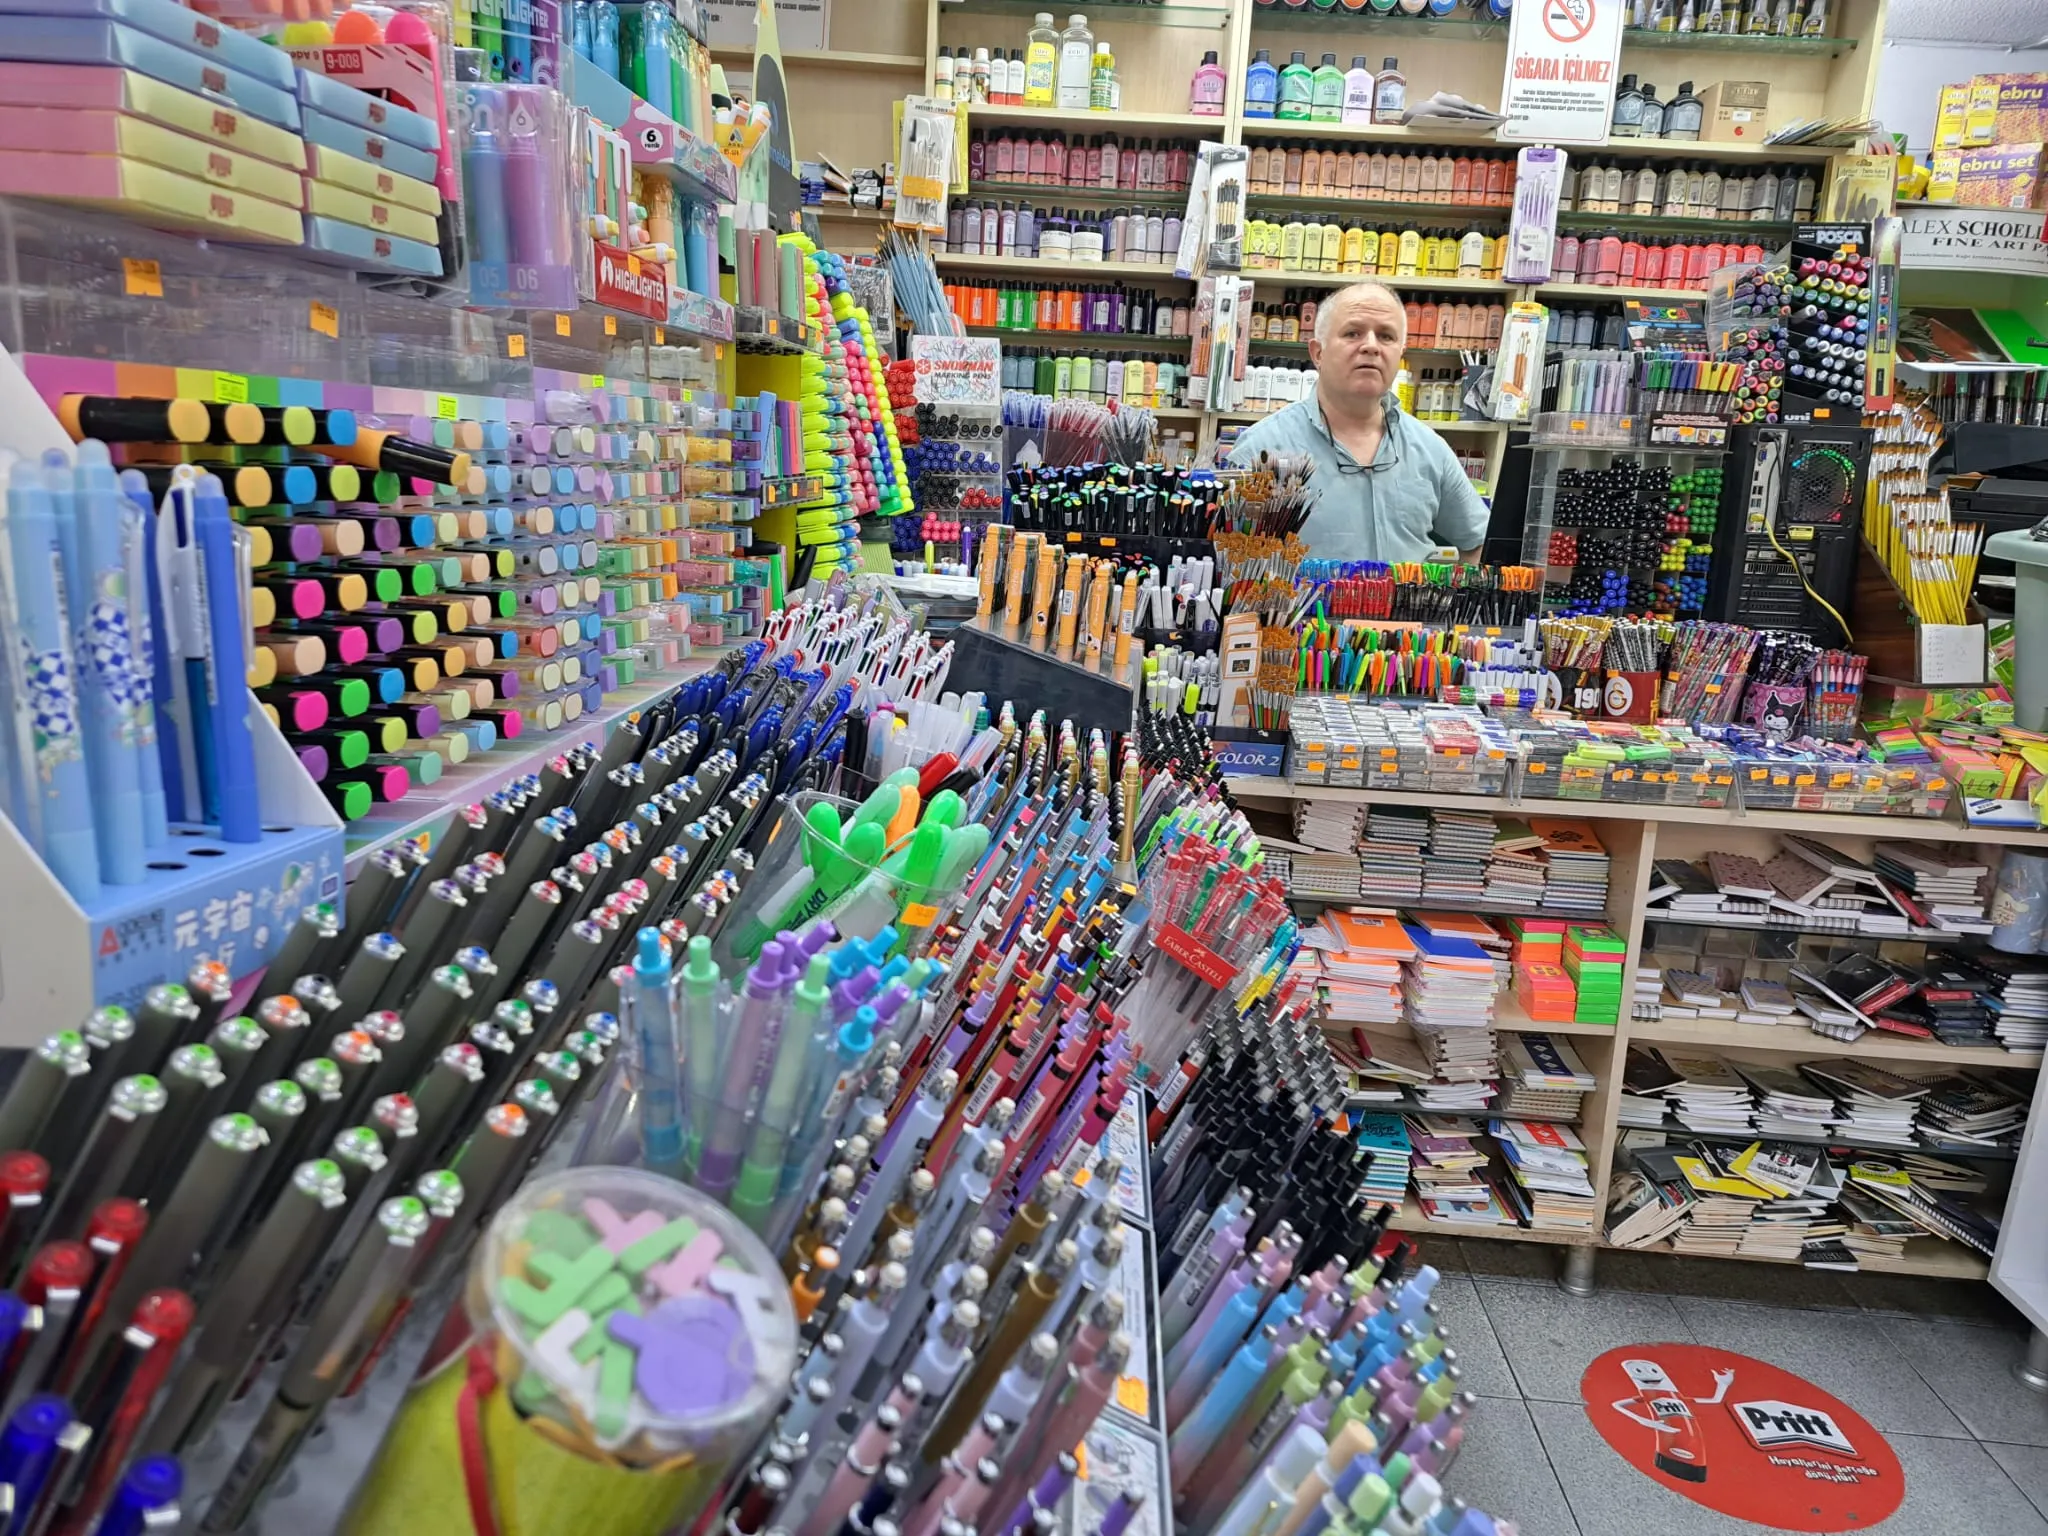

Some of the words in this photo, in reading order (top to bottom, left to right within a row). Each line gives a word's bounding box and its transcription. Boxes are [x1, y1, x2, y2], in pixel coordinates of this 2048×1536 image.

[1514, 55, 1560, 80] SİGARA
[1562, 57, 1612, 84] İÇİLMEZ
[2000, 86, 2044, 100] ebru
[646, 130, 657, 142] 6
[1960, 159, 2003, 172] ebru
[2007, 154, 2036, 168] set
[1816, 229, 1865, 245] POSCA
[1932, 237, 1984, 248] FINE
[1988, 240, 2030, 251] ART
[516, 268, 539, 290] 06
[614, 267, 665, 304] HIGHLIGHTER
[1639, 306, 1690, 321] POSCA
[934, 359, 995, 372] SNOWMAN
[1784, 412, 1811, 421] uni
[1215, 752, 1267, 767] COLOR
[1268, 756, 1281, 766] 2
[803, 887, 829, 917] DRY
[173, 890, 254, 952] 元宇宙
[1652, 1401, 1688, 1413] Pritt
[1742, 1406, 1833, 1437] Pritt
